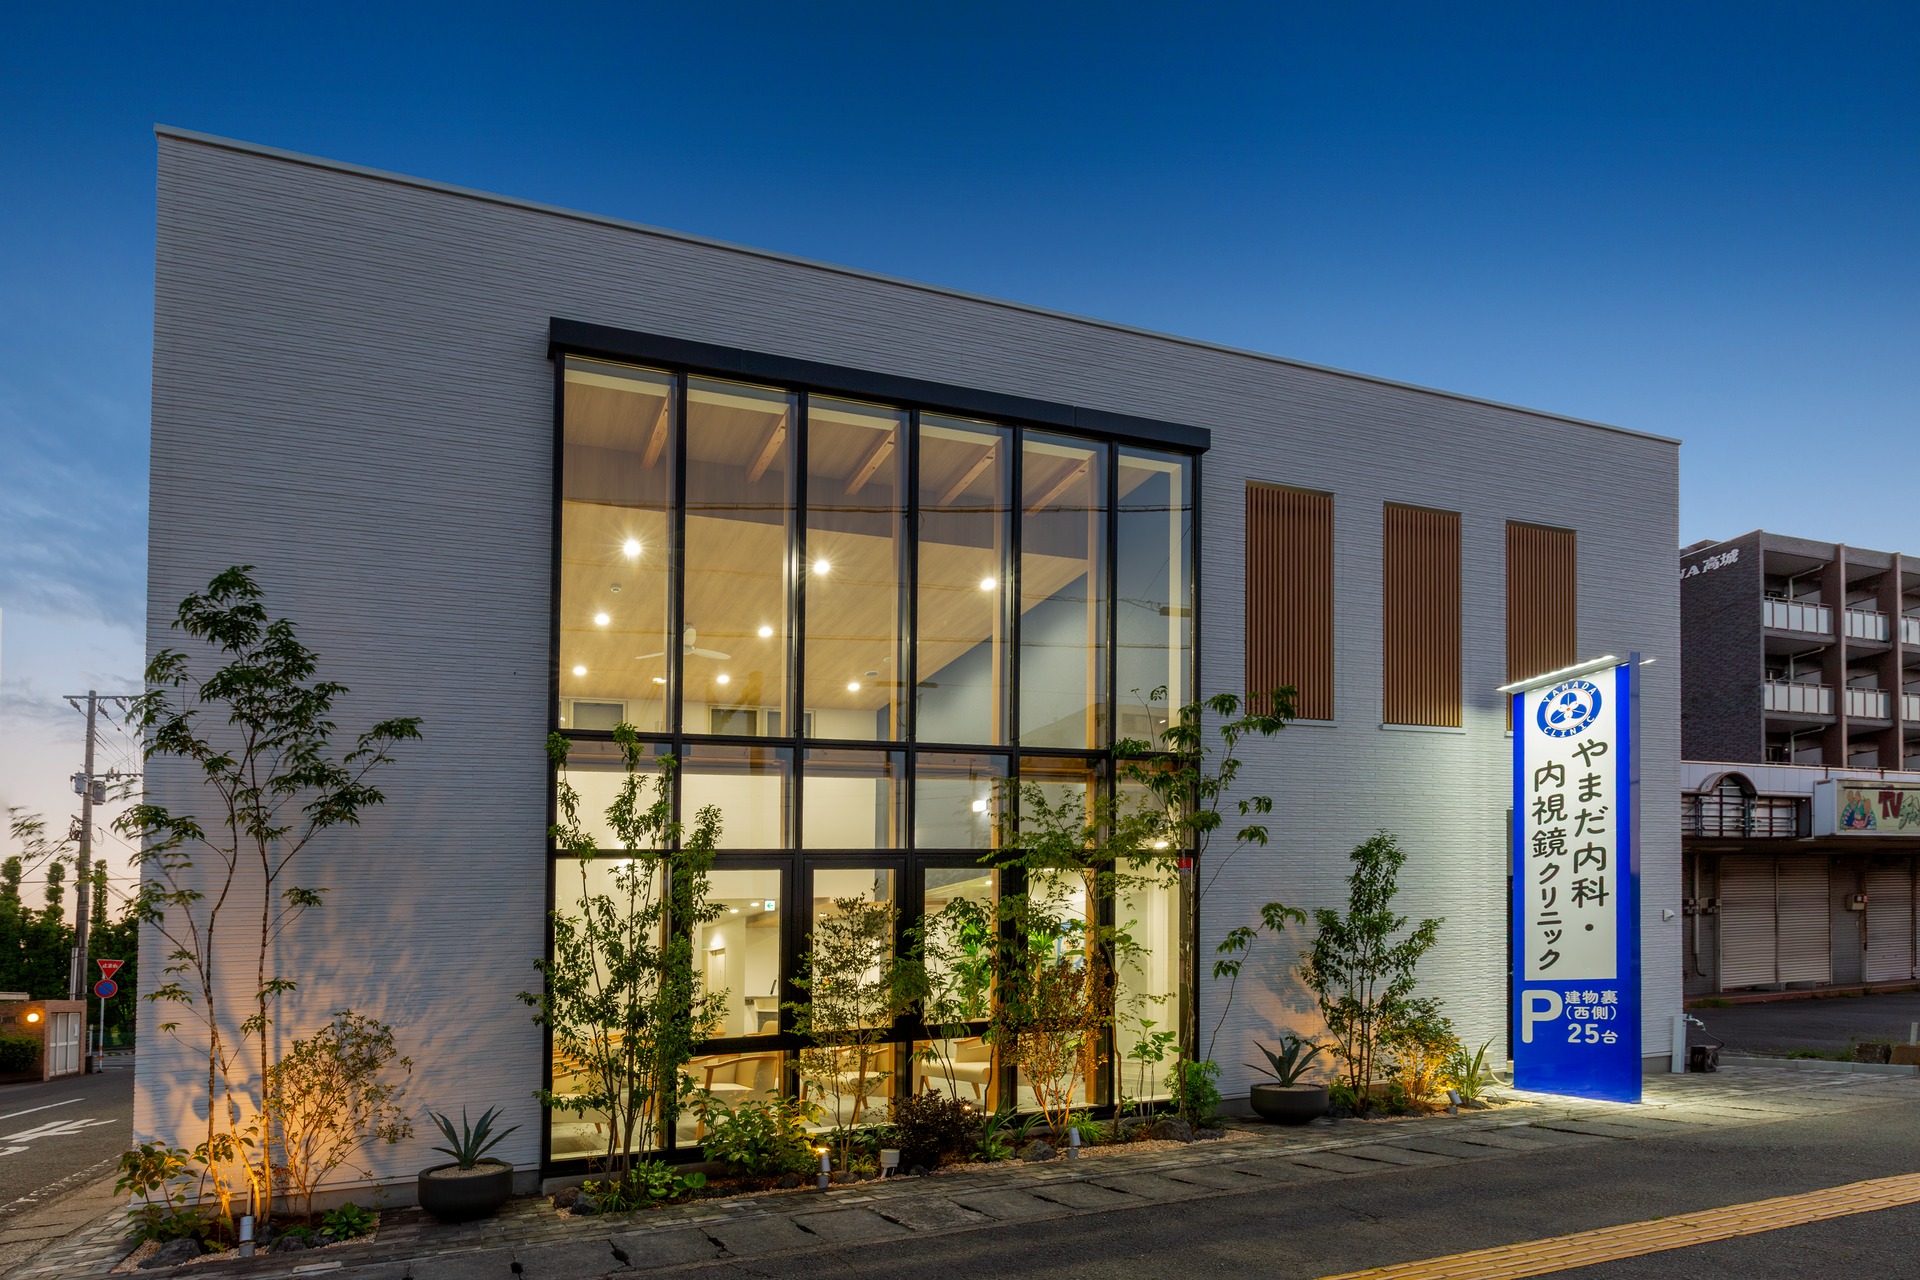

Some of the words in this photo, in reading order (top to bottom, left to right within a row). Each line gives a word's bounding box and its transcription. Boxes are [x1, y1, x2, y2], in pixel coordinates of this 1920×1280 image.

[1542, 681, 1597, 703] YAMADA
[1543, 716, 1595, 738] CLINIC
[1531, 760, 1568, 971] 内視鏡クリニック
[1564, 989, 1618, 1005] 建物裏
[1521, 989, 1563, 1044] P
[1567, 1023, 1618, 1044] 25台
